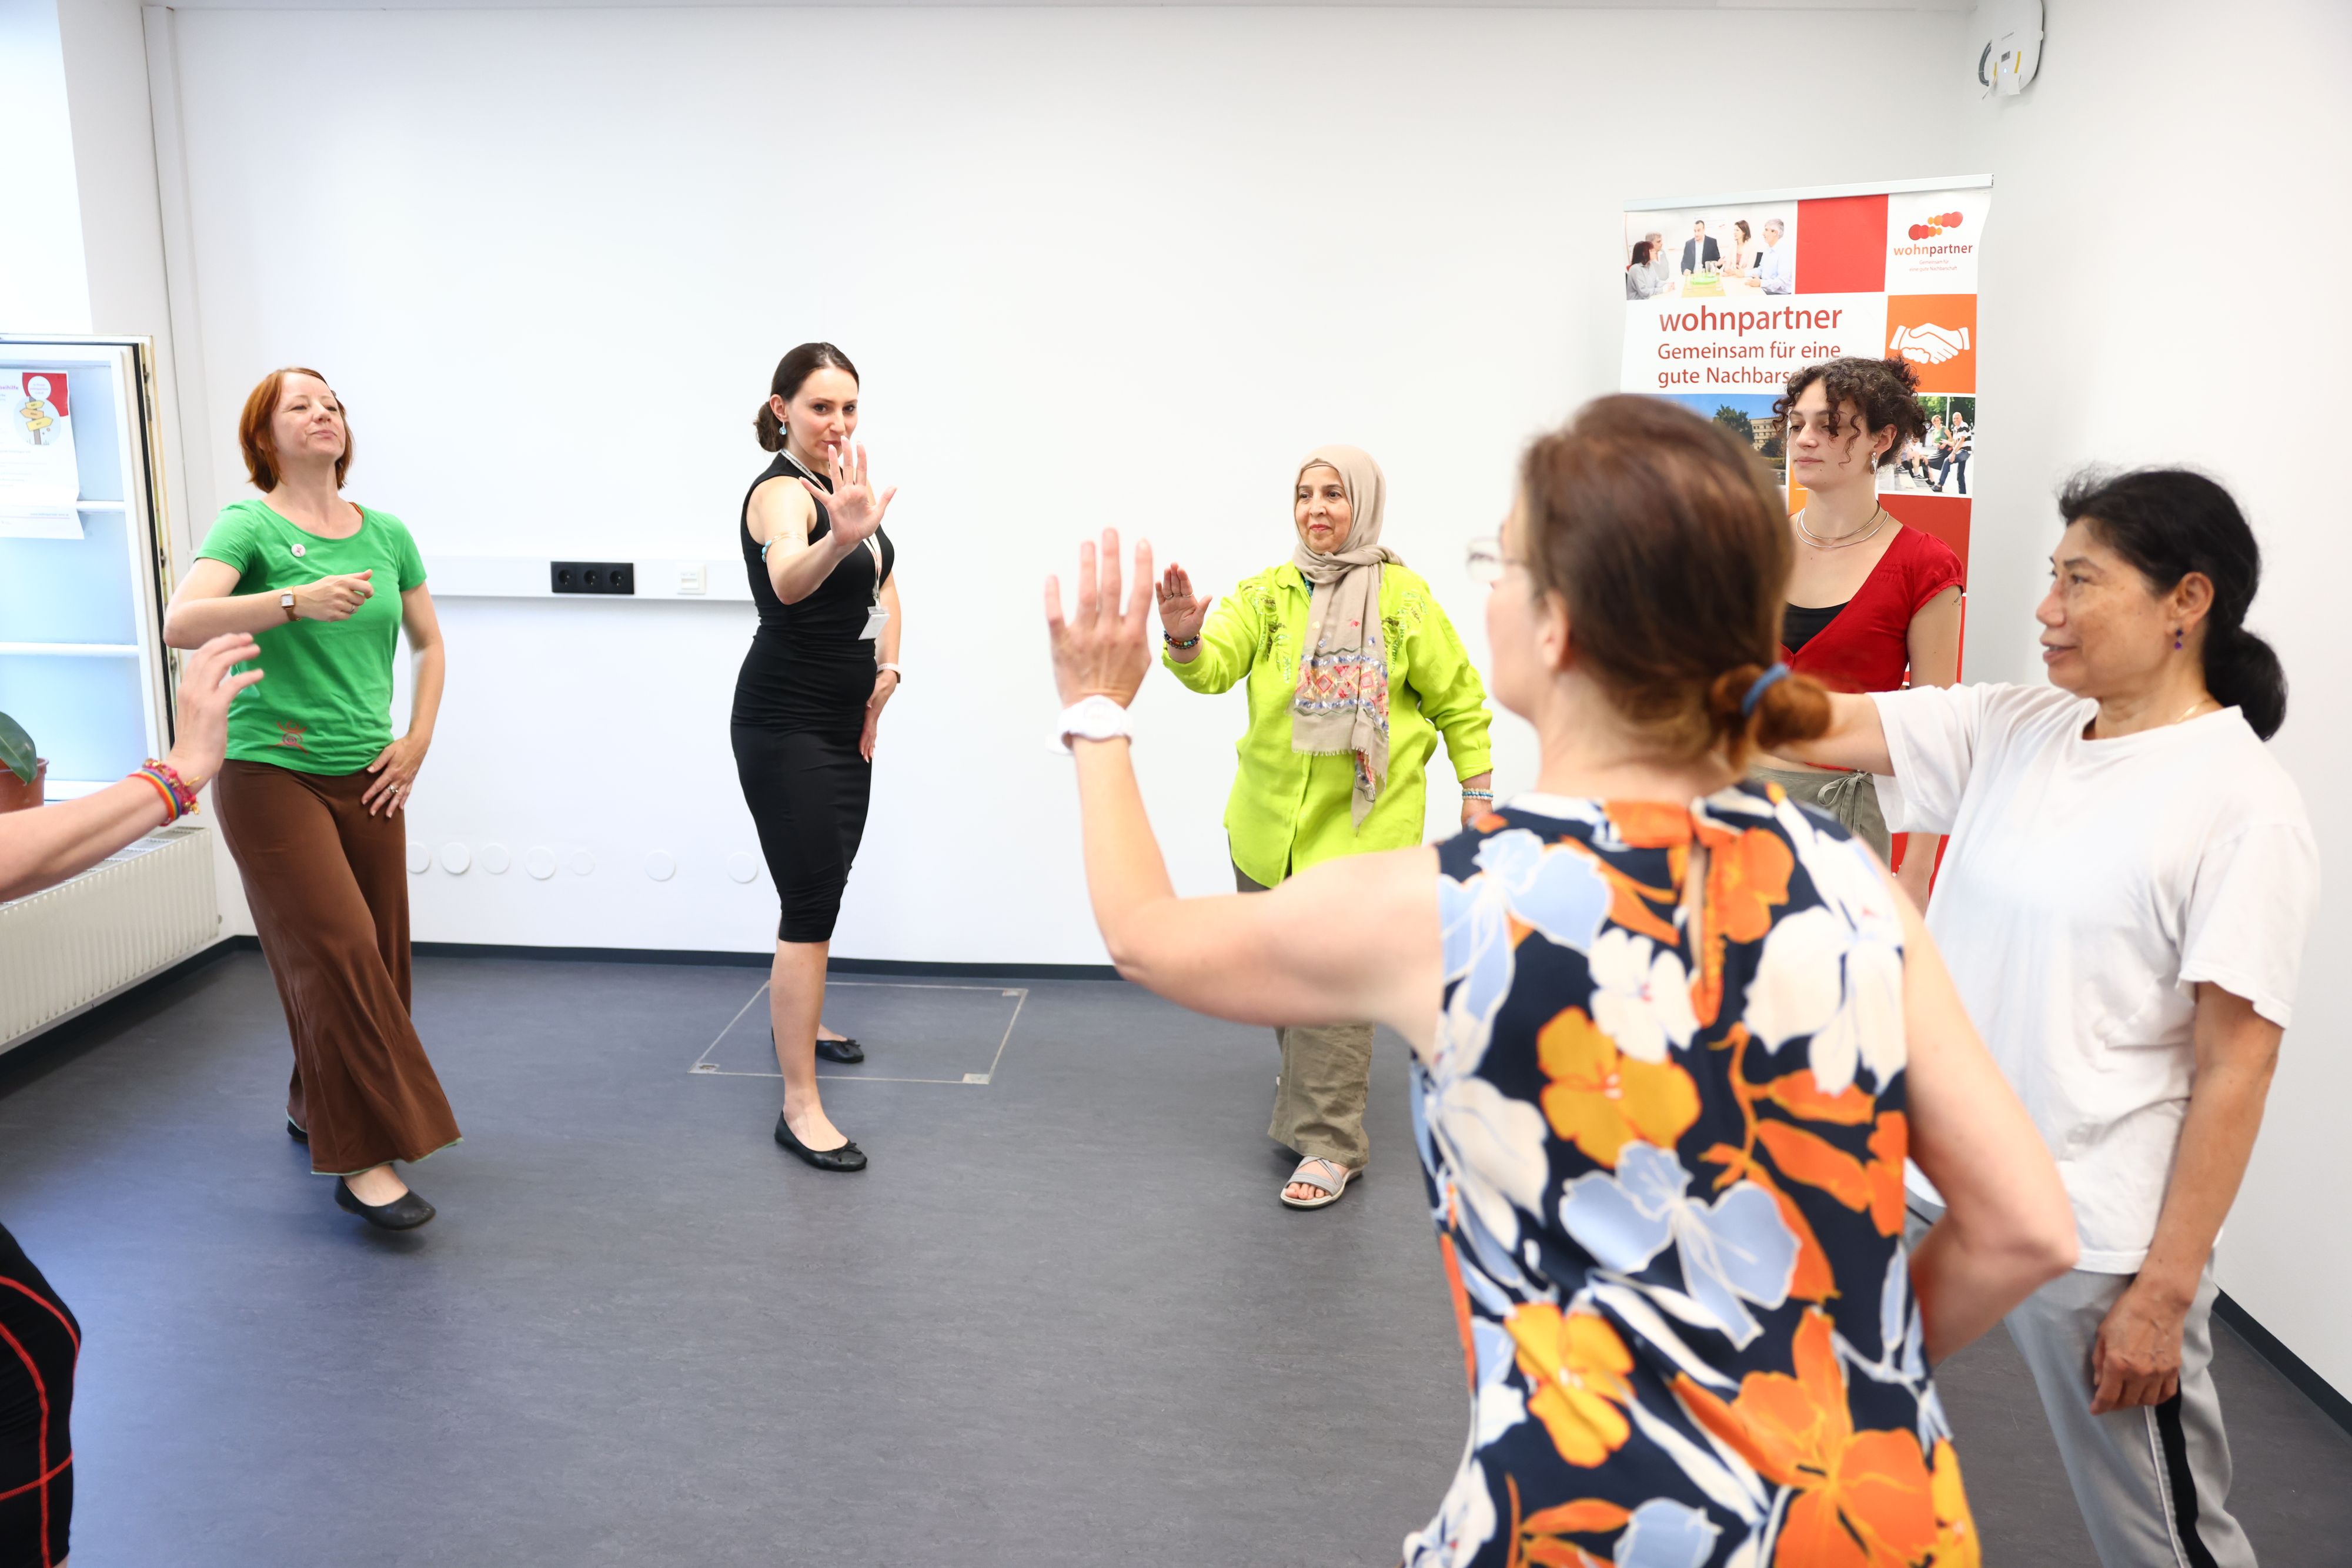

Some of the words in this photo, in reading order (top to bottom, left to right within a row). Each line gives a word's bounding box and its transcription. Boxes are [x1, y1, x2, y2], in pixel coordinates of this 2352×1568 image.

[1893, 243, 1973, 257] wohnpartner
[1659, 305, 1842, 337] wohnpartner
[1658, 342, 1764, 359] Gemeinsam
[1770, 341, 1795, 358] für
[1801, 342, 1840, 358] eine
[1658, 369, 1700, 388] gute
[1707, 367, 1805, 383] Nachbars
